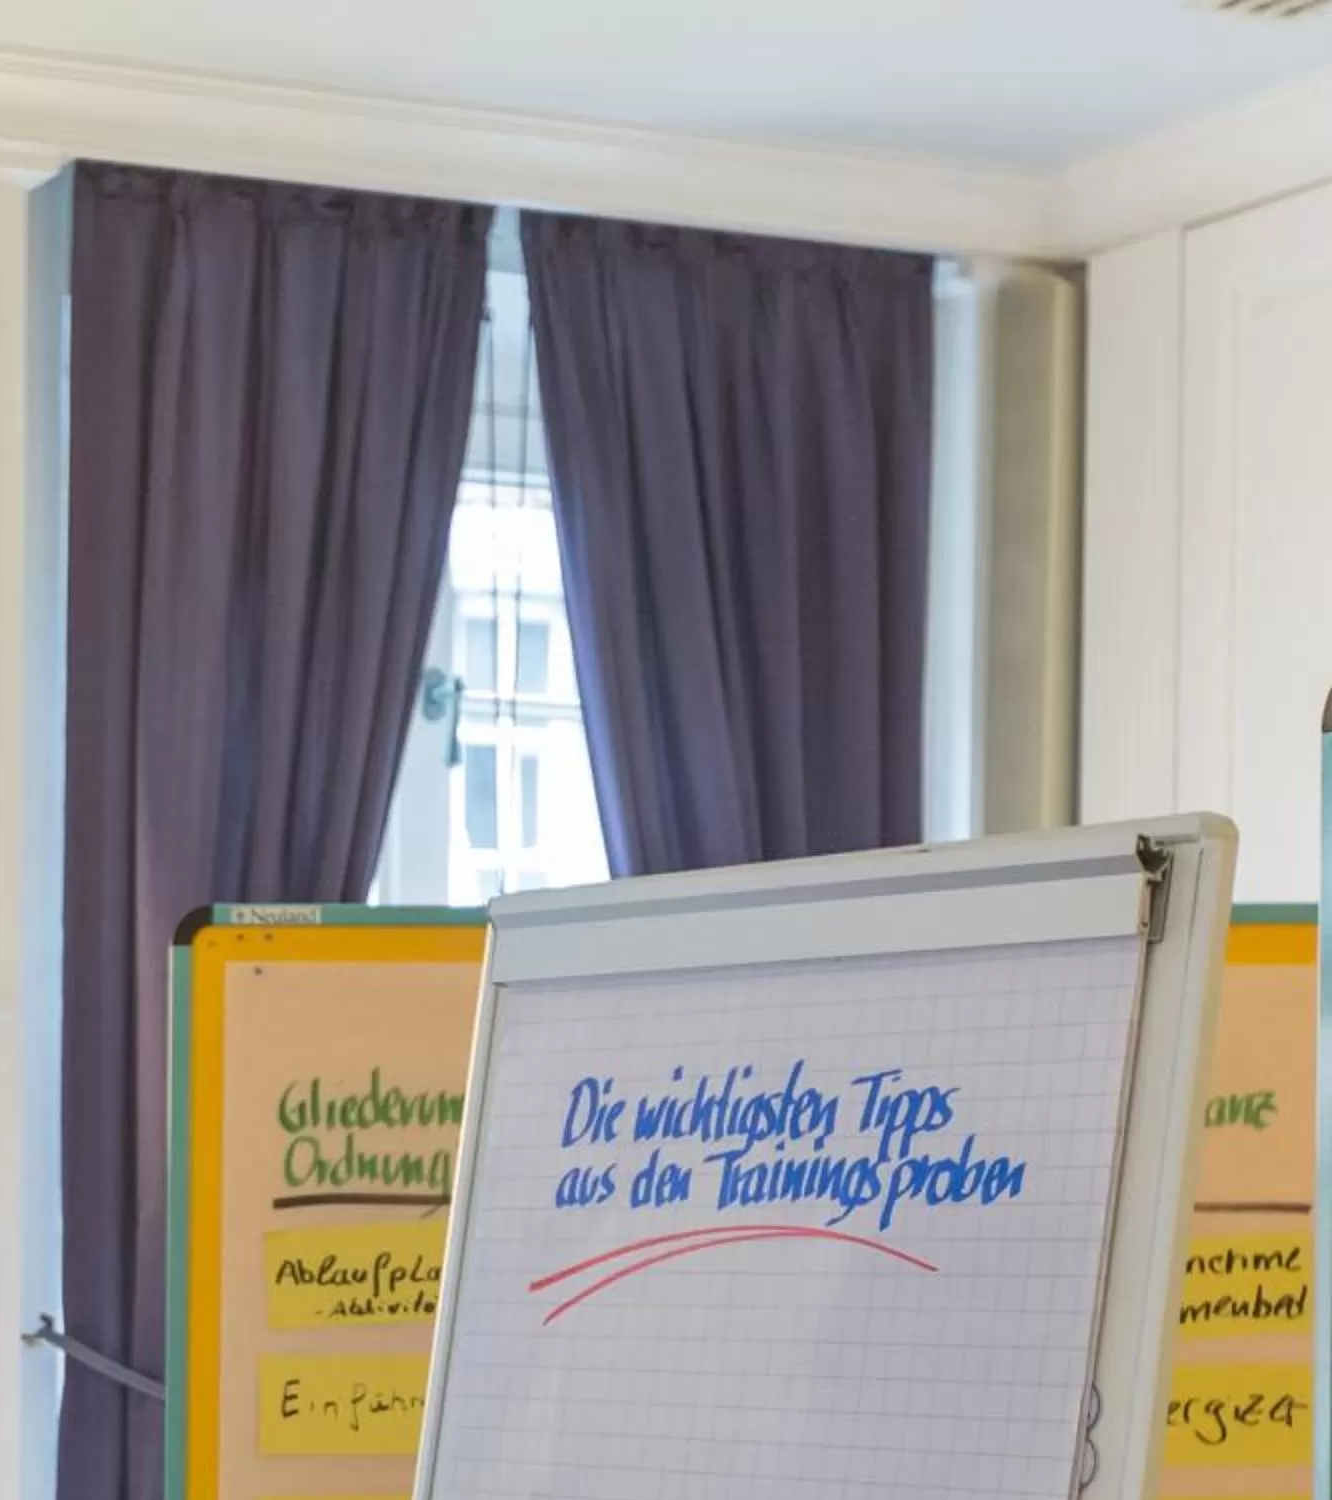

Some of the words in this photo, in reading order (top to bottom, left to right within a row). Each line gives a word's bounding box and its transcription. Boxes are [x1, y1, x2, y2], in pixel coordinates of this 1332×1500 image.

[279, 1067, 465, 1134] Gliederun
[560, 1076, 626, 1148] Die
[634, 1058, 840, 1152] wichtigsten
[851, 1068, 961, 1162] Tipps
[1203, 1089, 1279, 1132] anz
[283, 1132, 453, 1219] Ordnung
[555, 1163, 617, 1208] aus
[629, 1148, 692, 1208] den
[703, 1134, 1026, 1231] Trainingsproben
[275, 1251, 443, 1299] Ablaufpla
[1186, 1246, 1302, 1275] nehme
